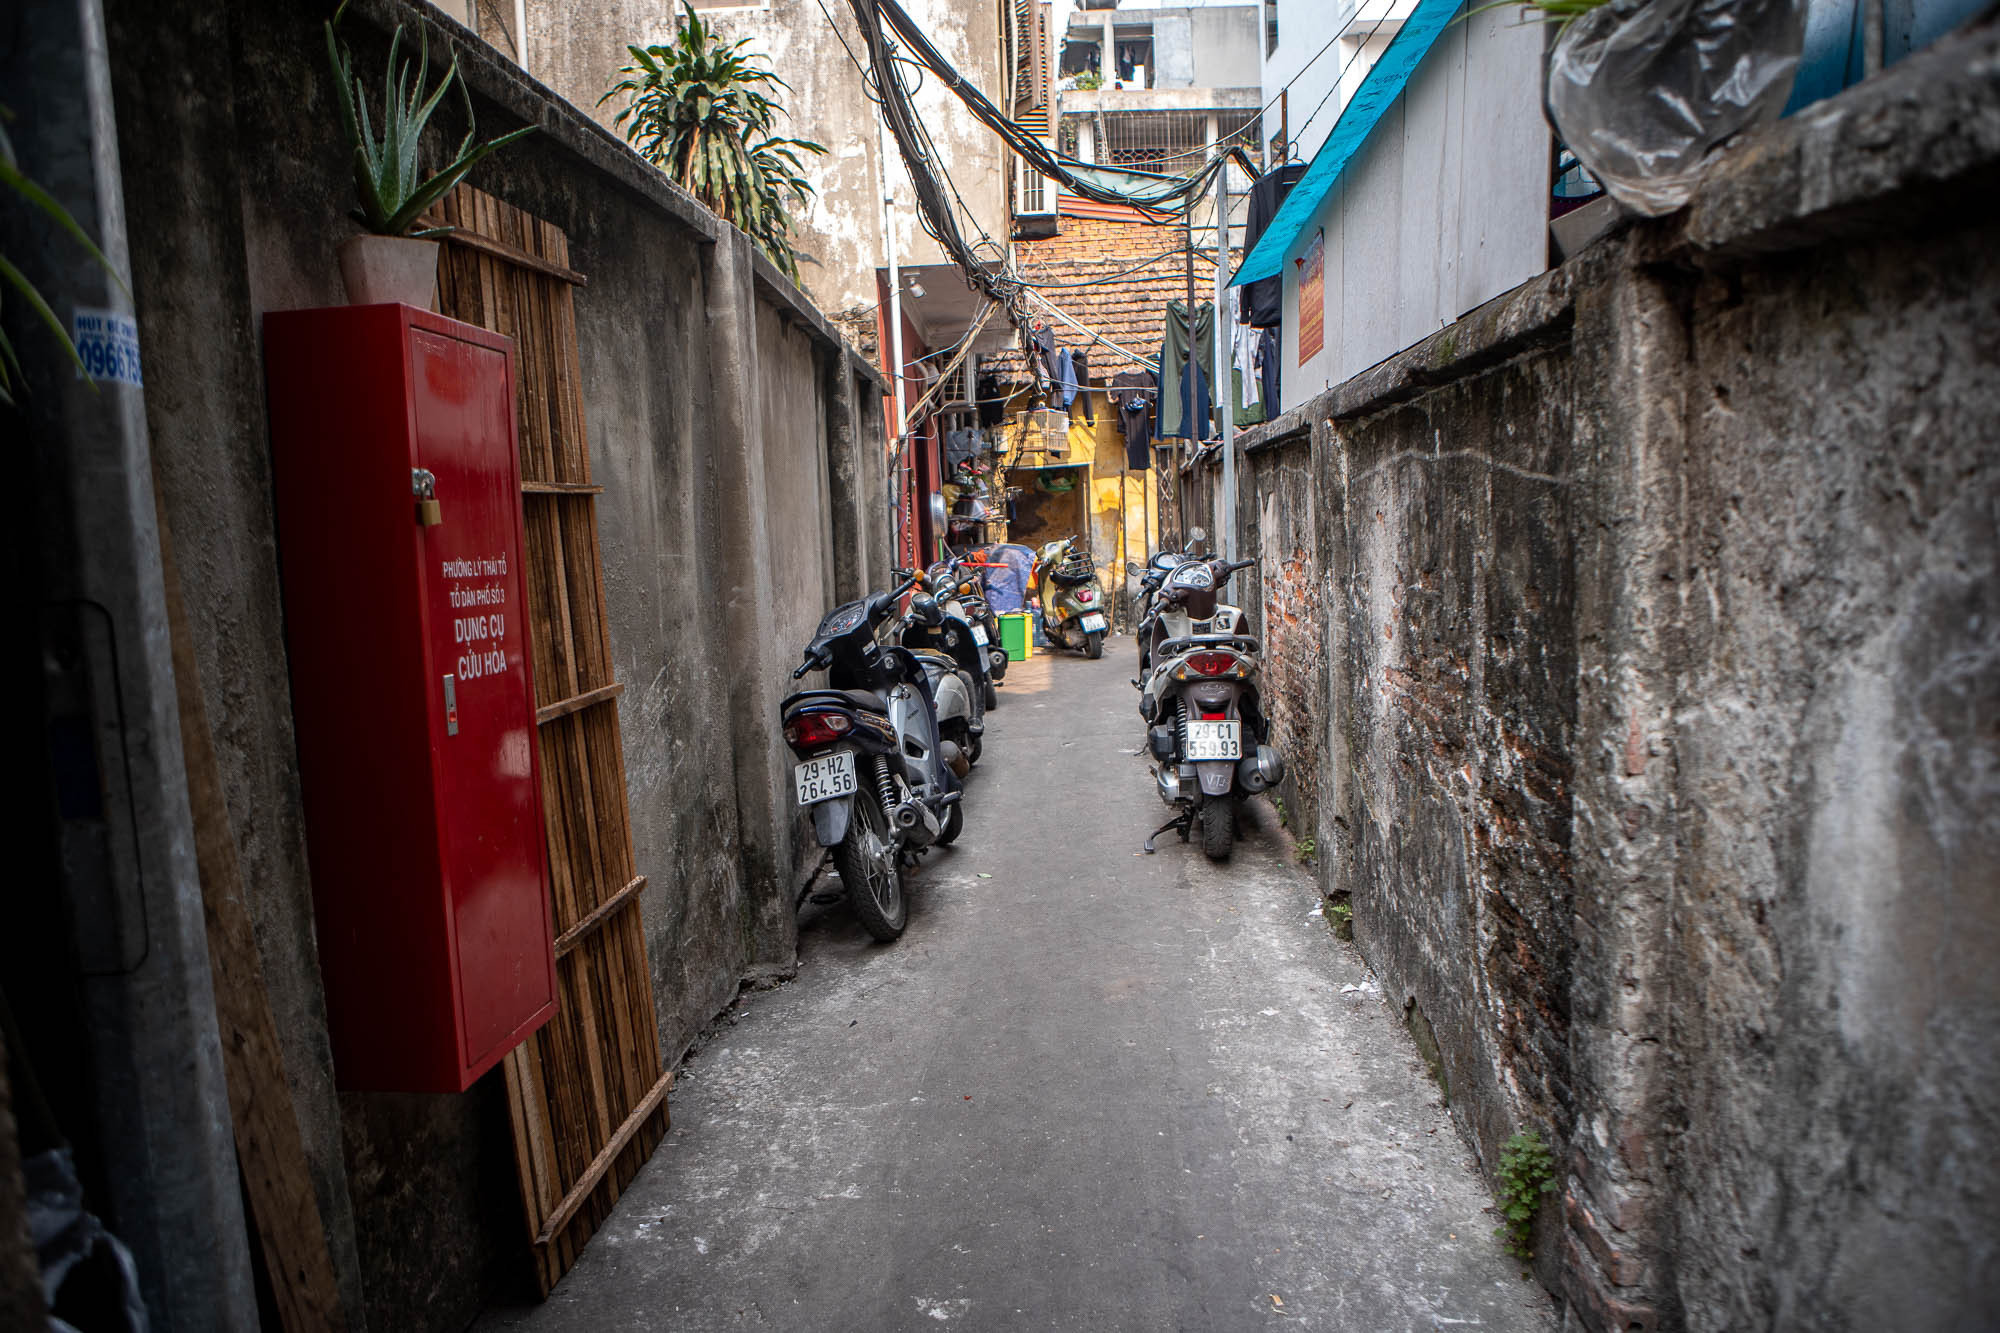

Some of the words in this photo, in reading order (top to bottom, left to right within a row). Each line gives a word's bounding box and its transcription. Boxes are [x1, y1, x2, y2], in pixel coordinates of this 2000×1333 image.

[443, 556, 473, 578] PHƯỜNG
[473, 556, 482, 576] LÝ
[483, 556, 498, 576] THÁI
[497, 552, 507, 575] TỔ
[450, 582, 461, 608] TỔ
[461, 586, 476, 607] DÂN
[476, 582, 491, 606] PHỐ
[491, 582, 501, 604] SỐ
[500, 588, 505, 603] 3
[455, 616, 488, 647] DỤNG
[490, 614, 505, 641] CỤ
[458, 648, 482, 680] CỨU
[484, 641, 507, 676] HỎA
[1195, 724, 1231, 739] 29-C1
[1189, 741, 1238, 756] 559.93
[802, 756, 845, 782] 29-H2
[800, 773, 852, 802] 264.56
